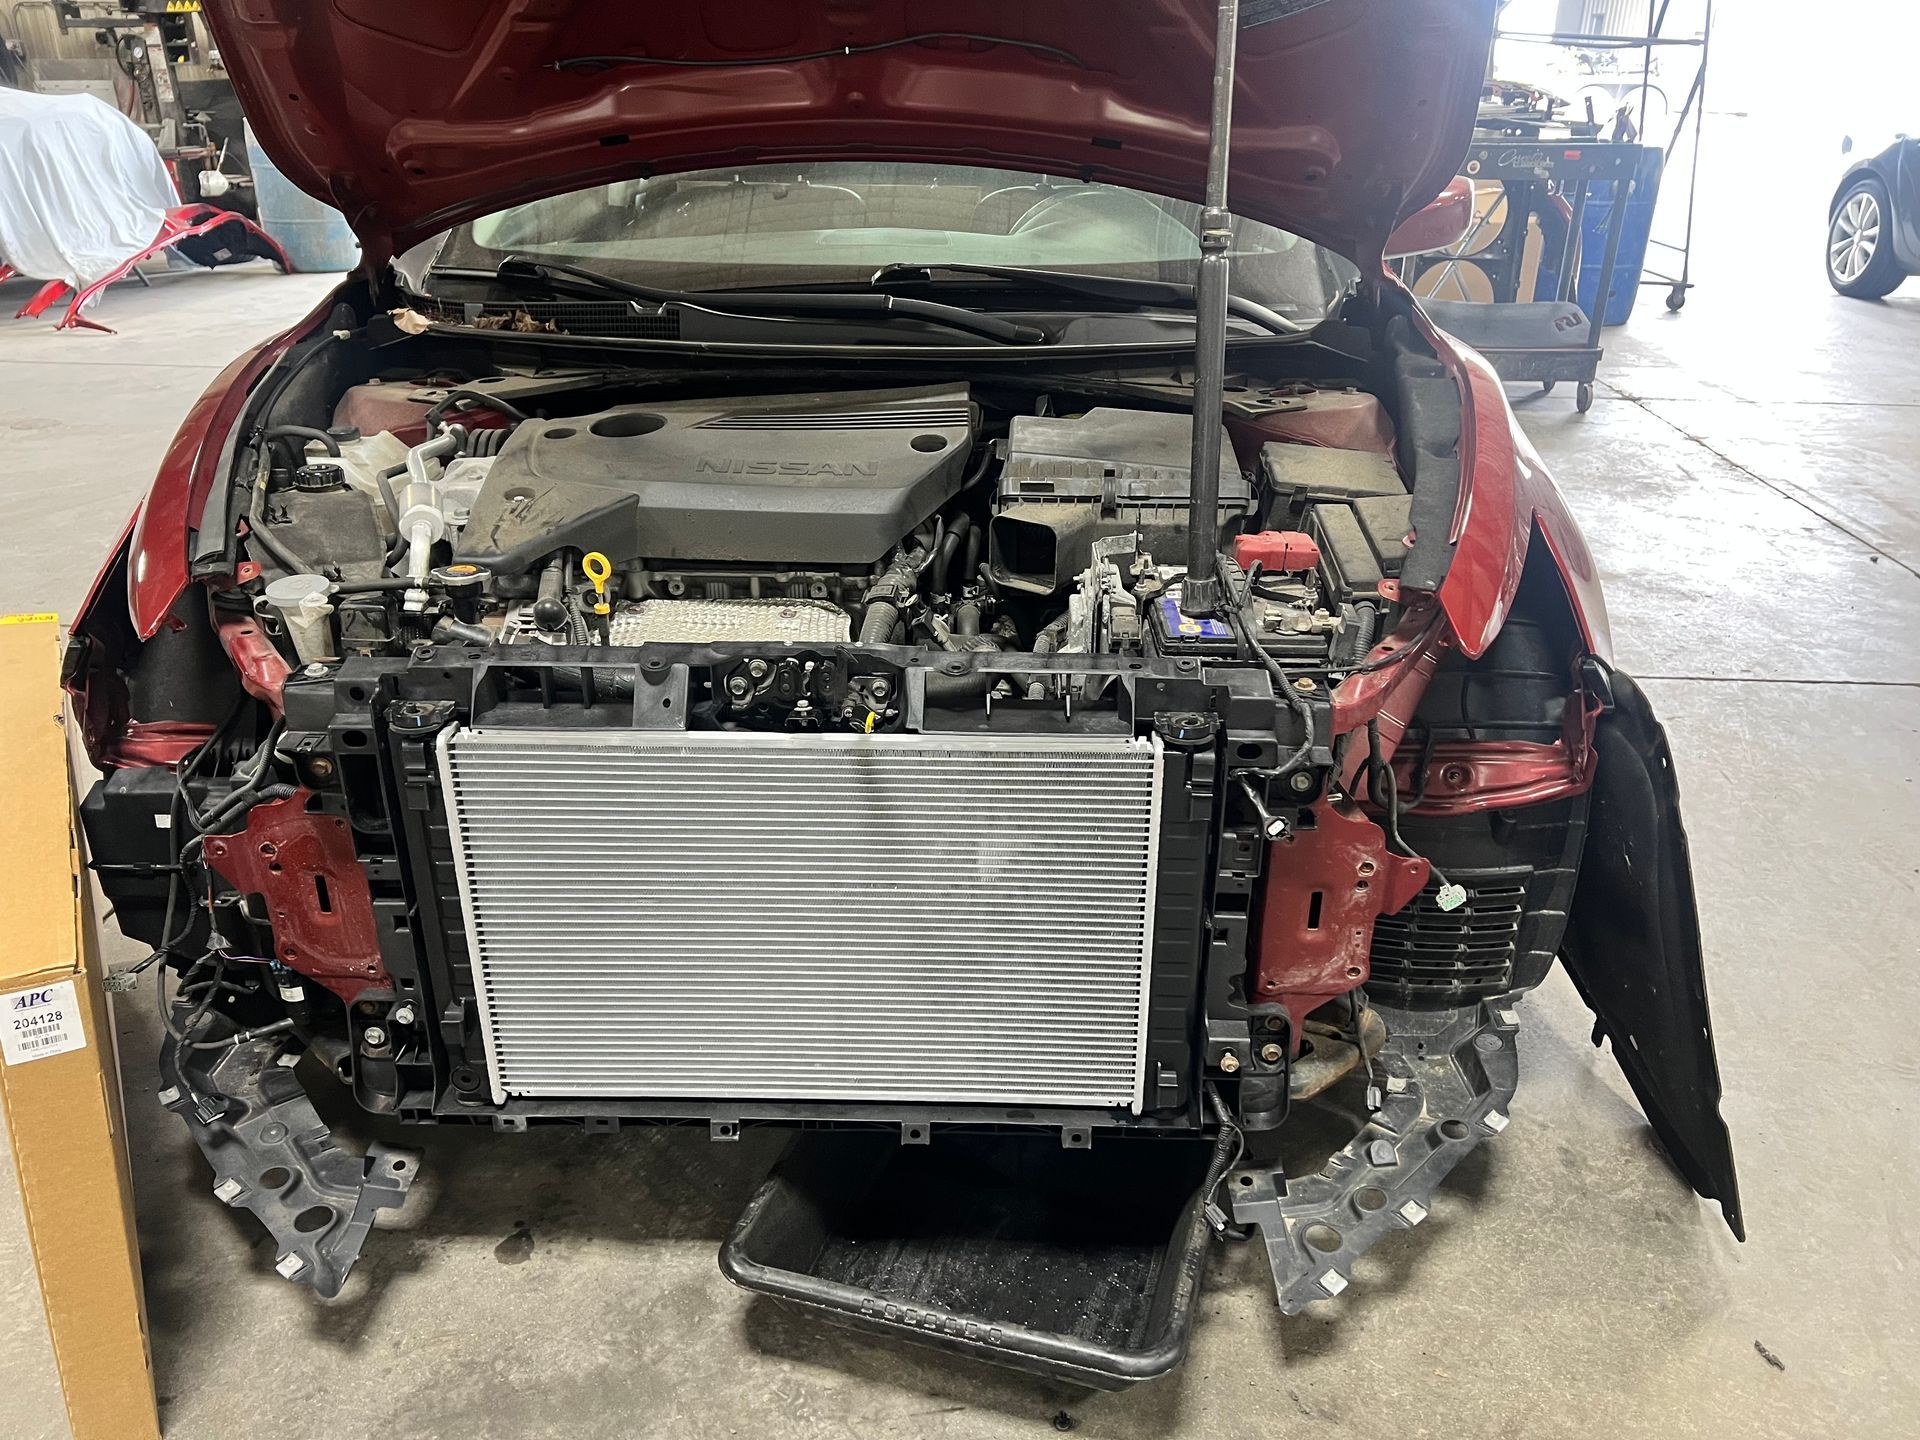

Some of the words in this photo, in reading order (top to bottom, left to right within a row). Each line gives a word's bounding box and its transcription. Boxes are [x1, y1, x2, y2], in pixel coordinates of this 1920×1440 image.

[696, 458, 879, 477] NISSAN
[14, 988, 54, 1010] APC
[13, 1010, 63, 1030] 204128
